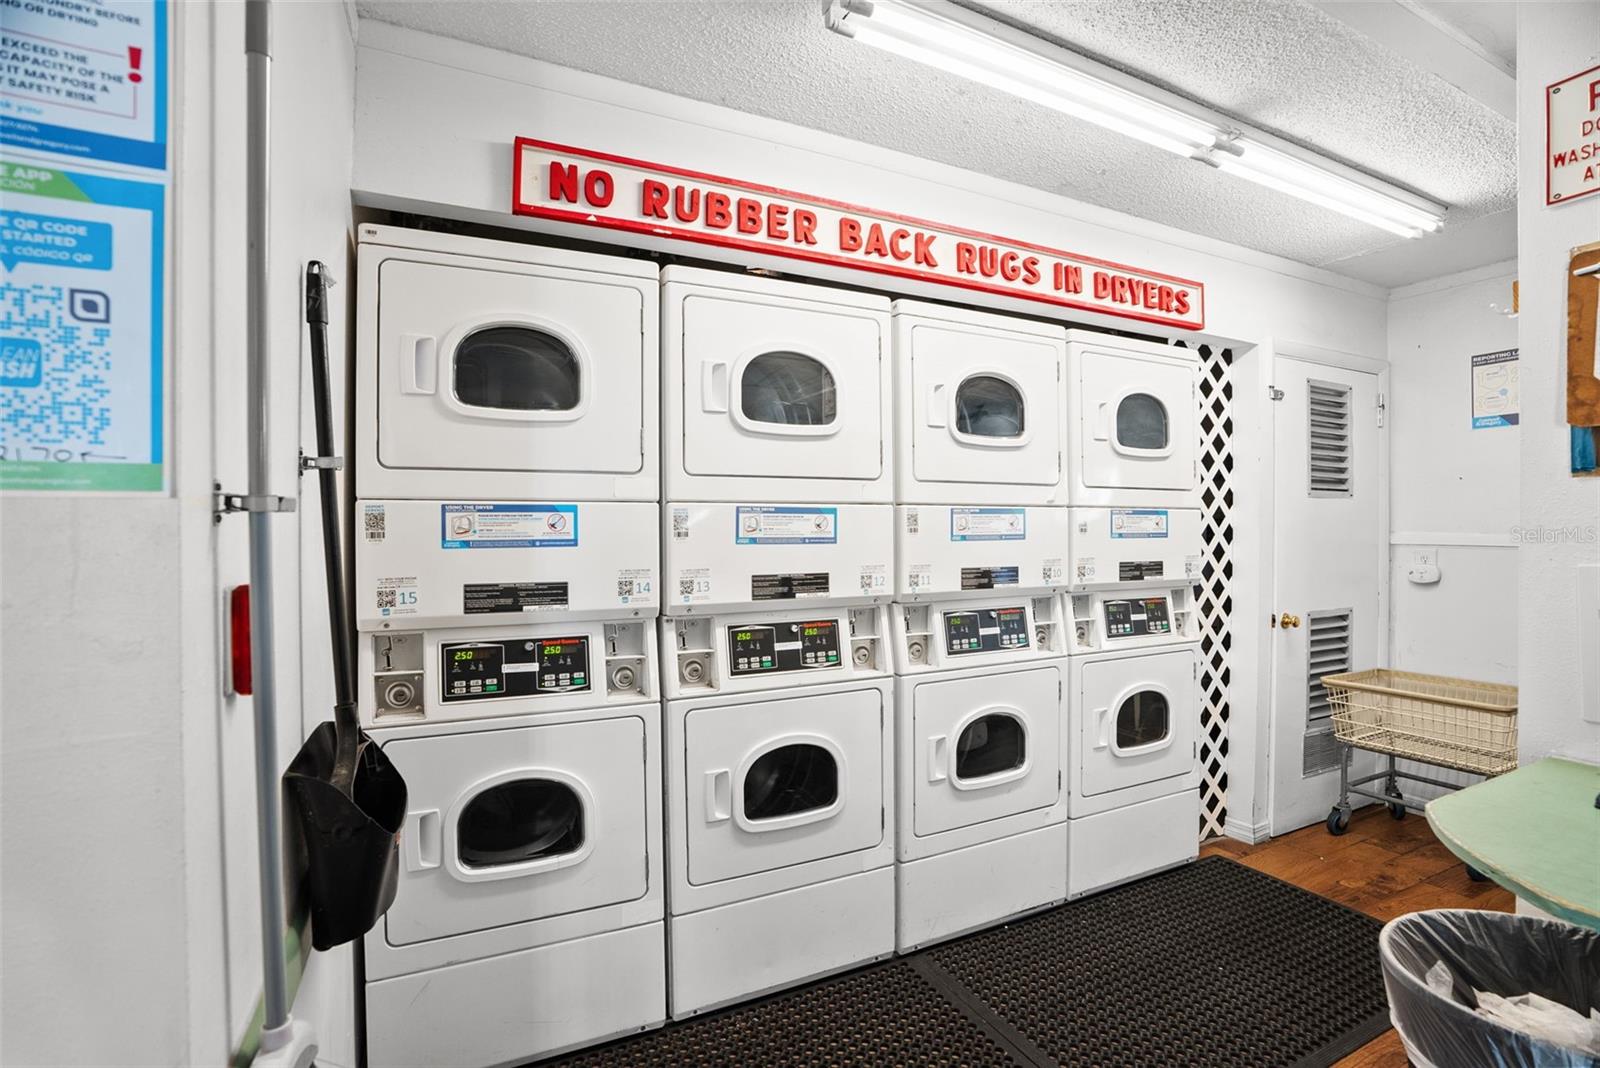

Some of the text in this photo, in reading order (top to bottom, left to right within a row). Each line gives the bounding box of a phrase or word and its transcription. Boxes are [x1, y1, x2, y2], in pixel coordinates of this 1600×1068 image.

[24, 2, 45, 15] OR
[47, 8, 99, 28] DRYING
[95, 8, 141, 26] BEFORE
[1, 36, 89, 65] EXCEED THE
[0, 50, 124, 85] CAPACITY OF THE
[7, 63, 110, 94] IT MAY POSE A
[8, 78, 97, 105] SAFETY RISK
[12, 166, 53, 182] APP
[13, 217, 39, 231] QR
[42, 221, 88, 237] CODE
[2, 229, 78, 248] STARTED
[549, 160, 1191, 315] NO RUBBER BACK RUGS IN DRYERS
[72, 251, 94, 263] QR
[1472, 351, 1512, 363] REPORTING
[635, 581, 651, 595] 14
[696, 580, 711, 593] 13
[874, 575, 886, 587] 12
[399, 591, 418, 605] 15
